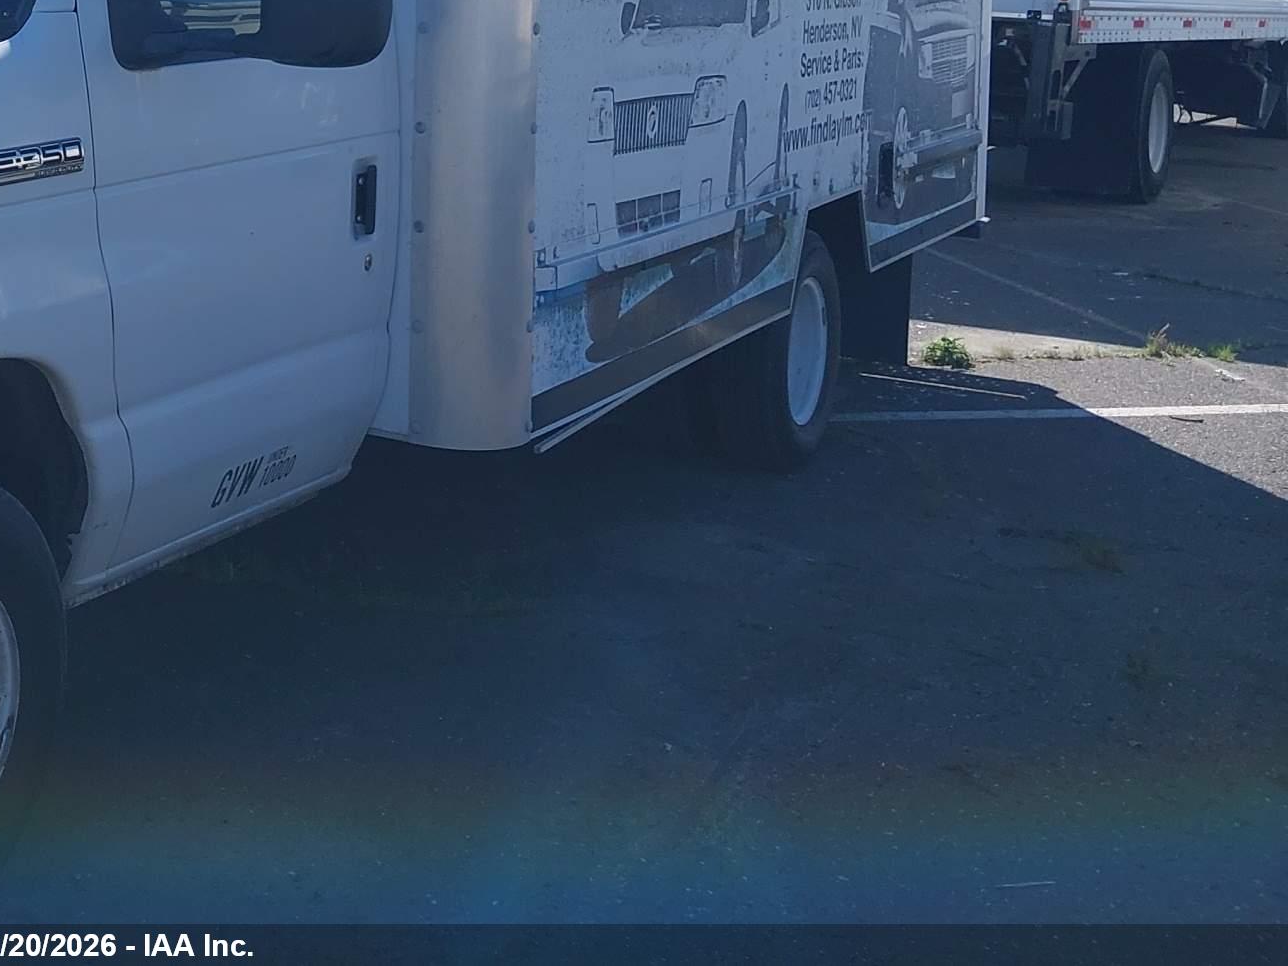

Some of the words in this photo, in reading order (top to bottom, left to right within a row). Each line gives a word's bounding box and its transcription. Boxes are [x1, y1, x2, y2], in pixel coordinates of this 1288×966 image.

[802, 18, 849, 45] Henderson,
[851, 14, 863, 38] NV
[800, 49, 832, 78] Service
[833, 49, 840, 71] &
[804, 88, 821, 114] (702)
[823, 77, 857, 105] 457-0321
[783, 110, 873, 153] www.findlaylm.com
[211, 455, 264, 508] GVW
